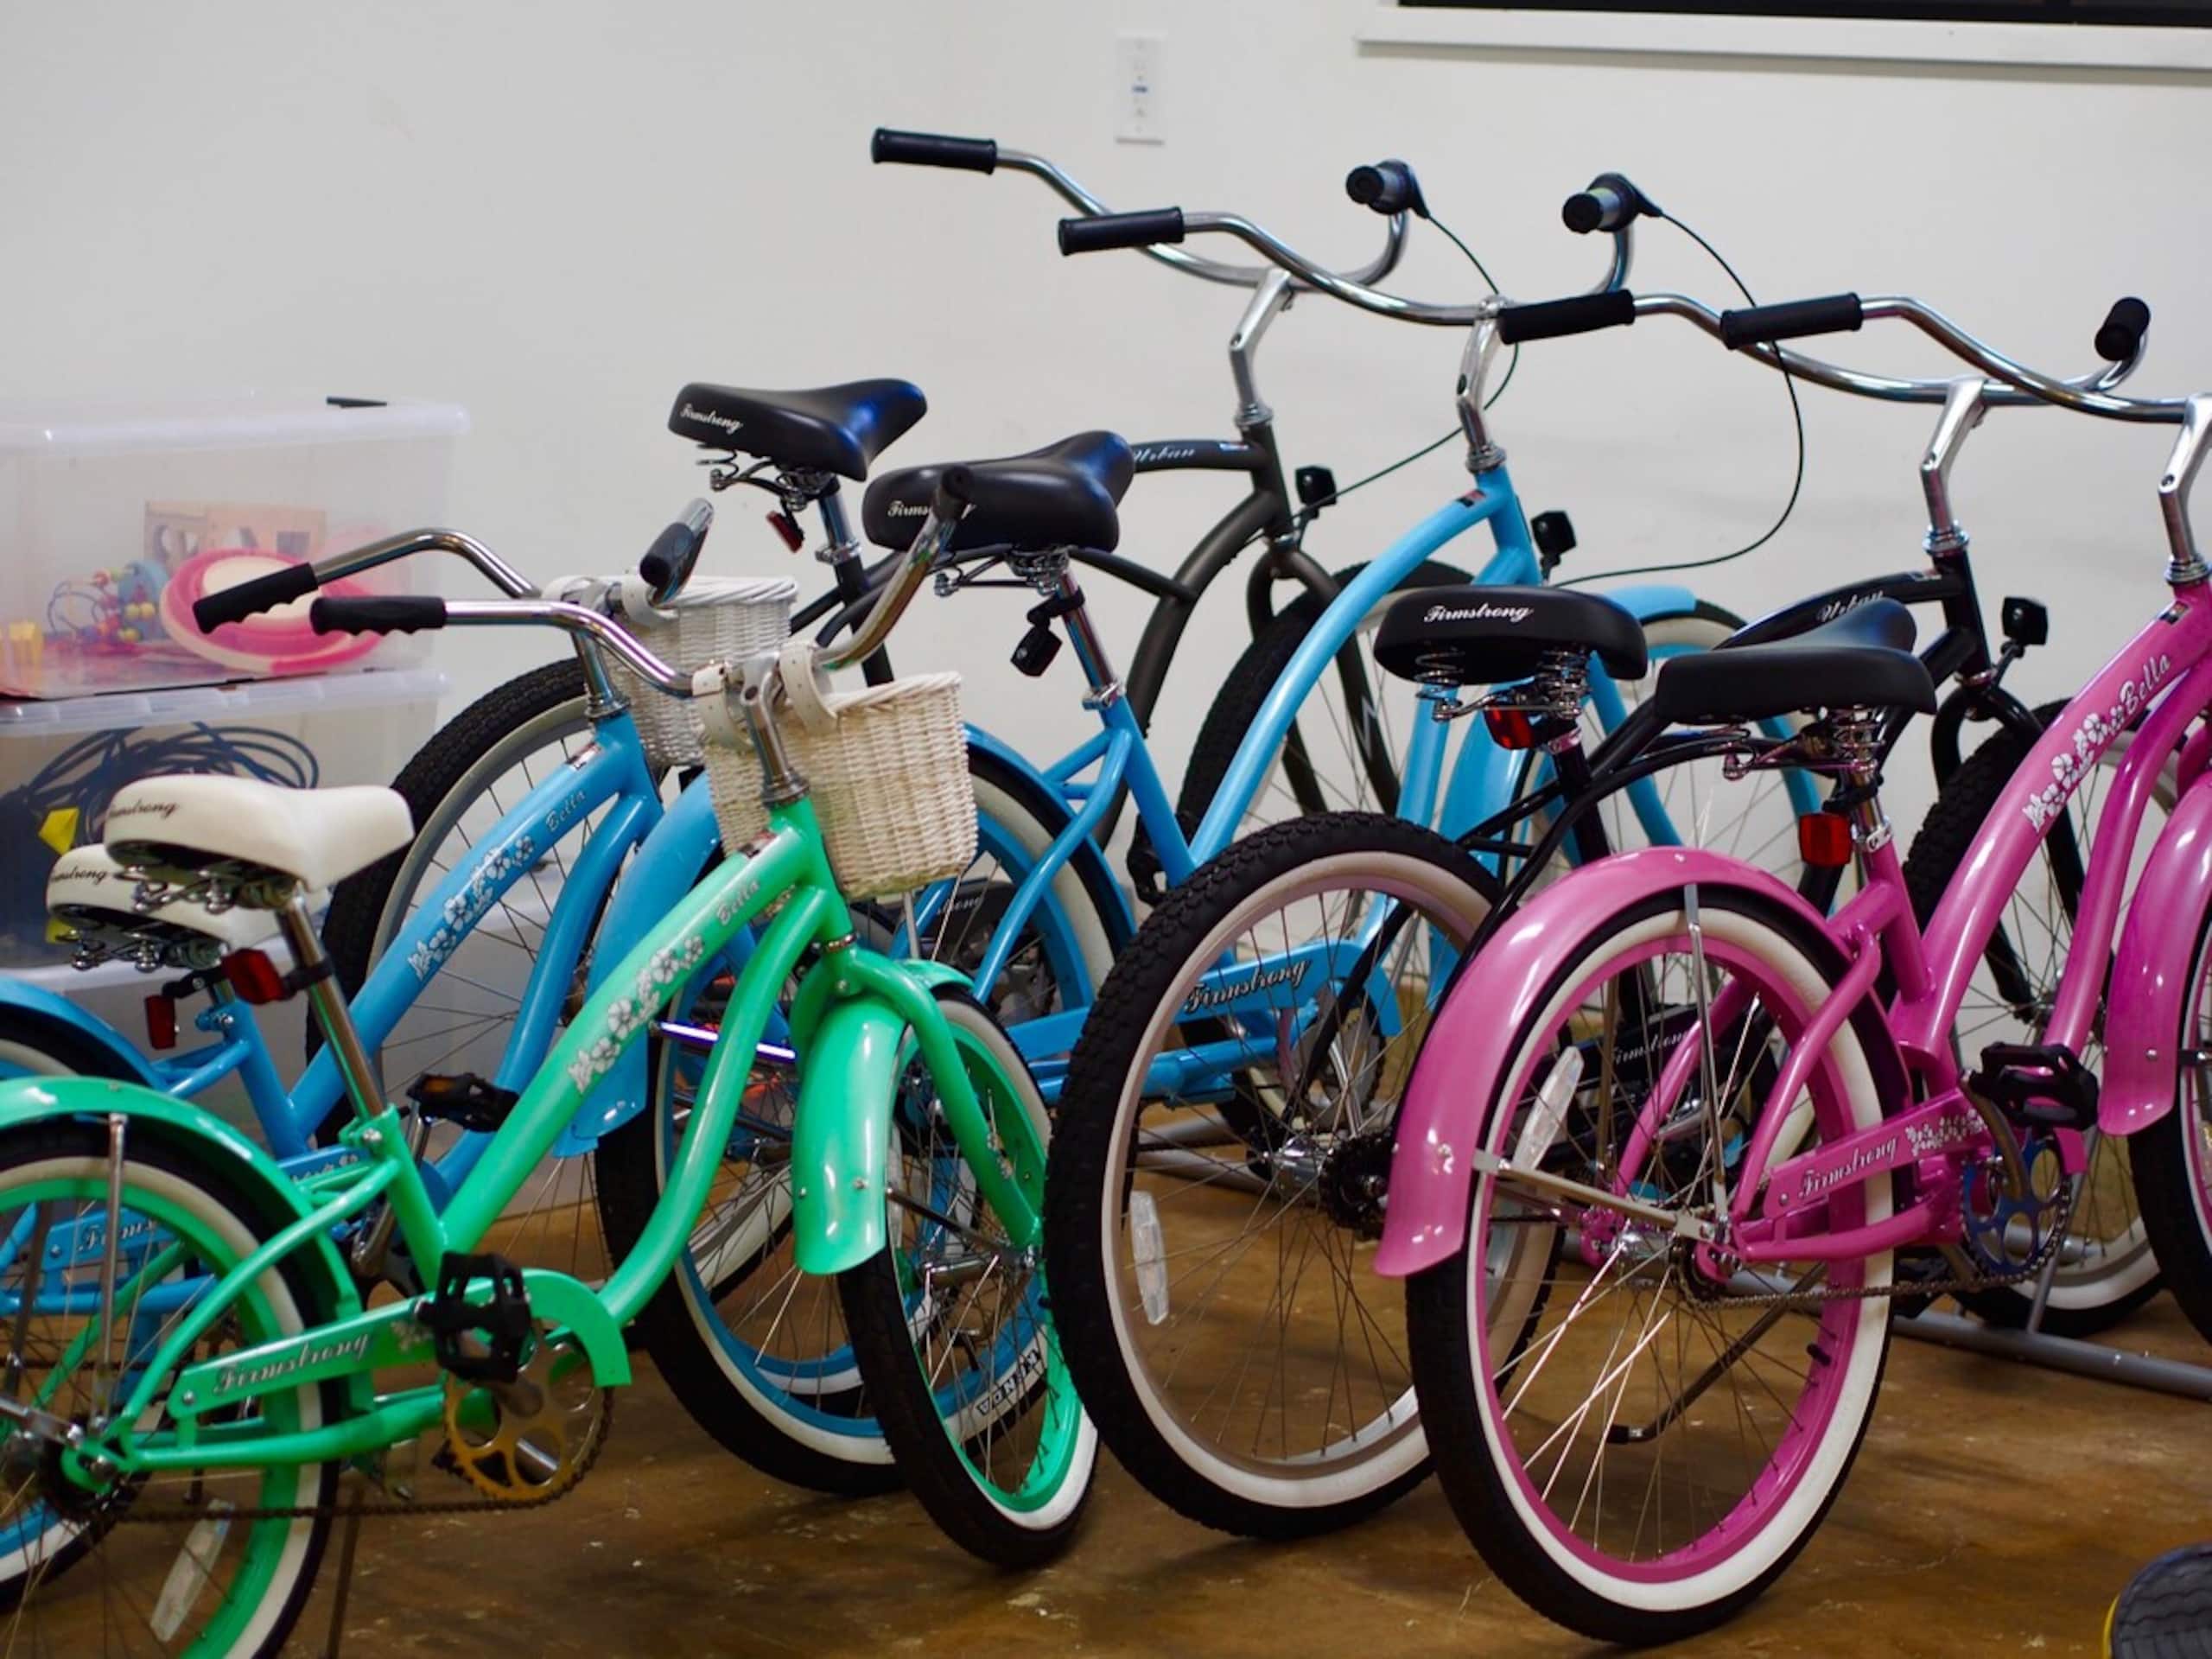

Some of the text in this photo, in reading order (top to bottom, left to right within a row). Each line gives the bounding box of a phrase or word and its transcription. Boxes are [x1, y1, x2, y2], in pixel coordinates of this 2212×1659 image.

[1423, 602, 1535, 622] Firmstrong
[2120, 654, 2171, 715] Bella
[546, 790, 586, 832] Bella
[716, 880, 760, 926] Bella
[1184, 959, 1313, 1013] Firmstrong
[1799, 1136, 1898, 1198] Firmstrong
[213, 1332, 371, 1395] Firmstrong
